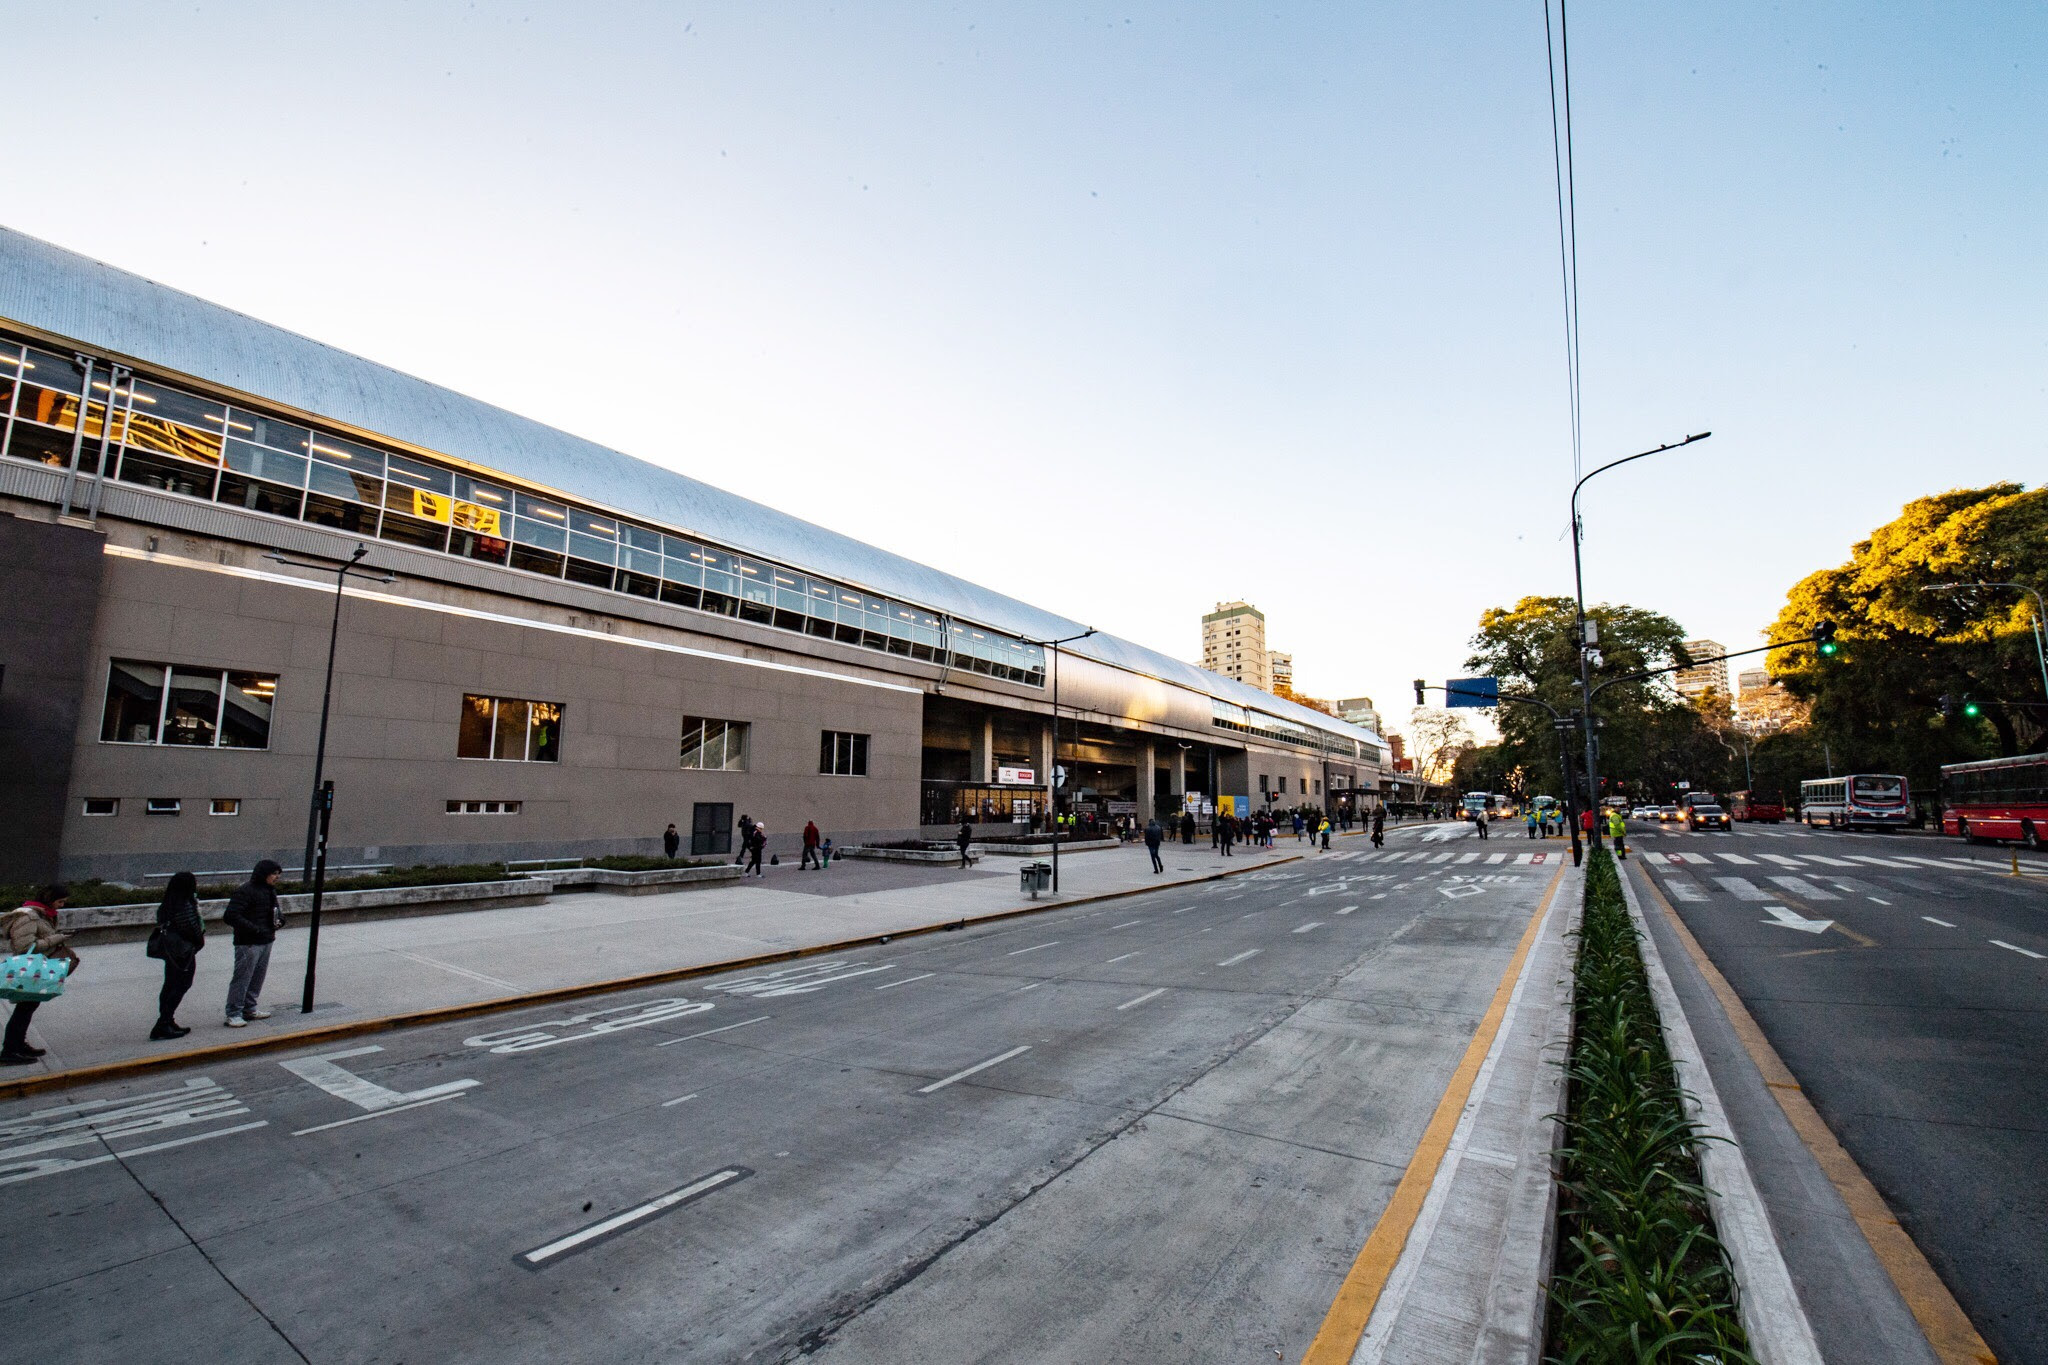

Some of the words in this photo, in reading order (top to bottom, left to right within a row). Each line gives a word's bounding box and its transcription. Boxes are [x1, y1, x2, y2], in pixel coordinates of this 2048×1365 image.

[1443, 875, 1521, 884] BUS
[702, 961, 898, 998] 113
[464, 997, 716, 1054] 63
